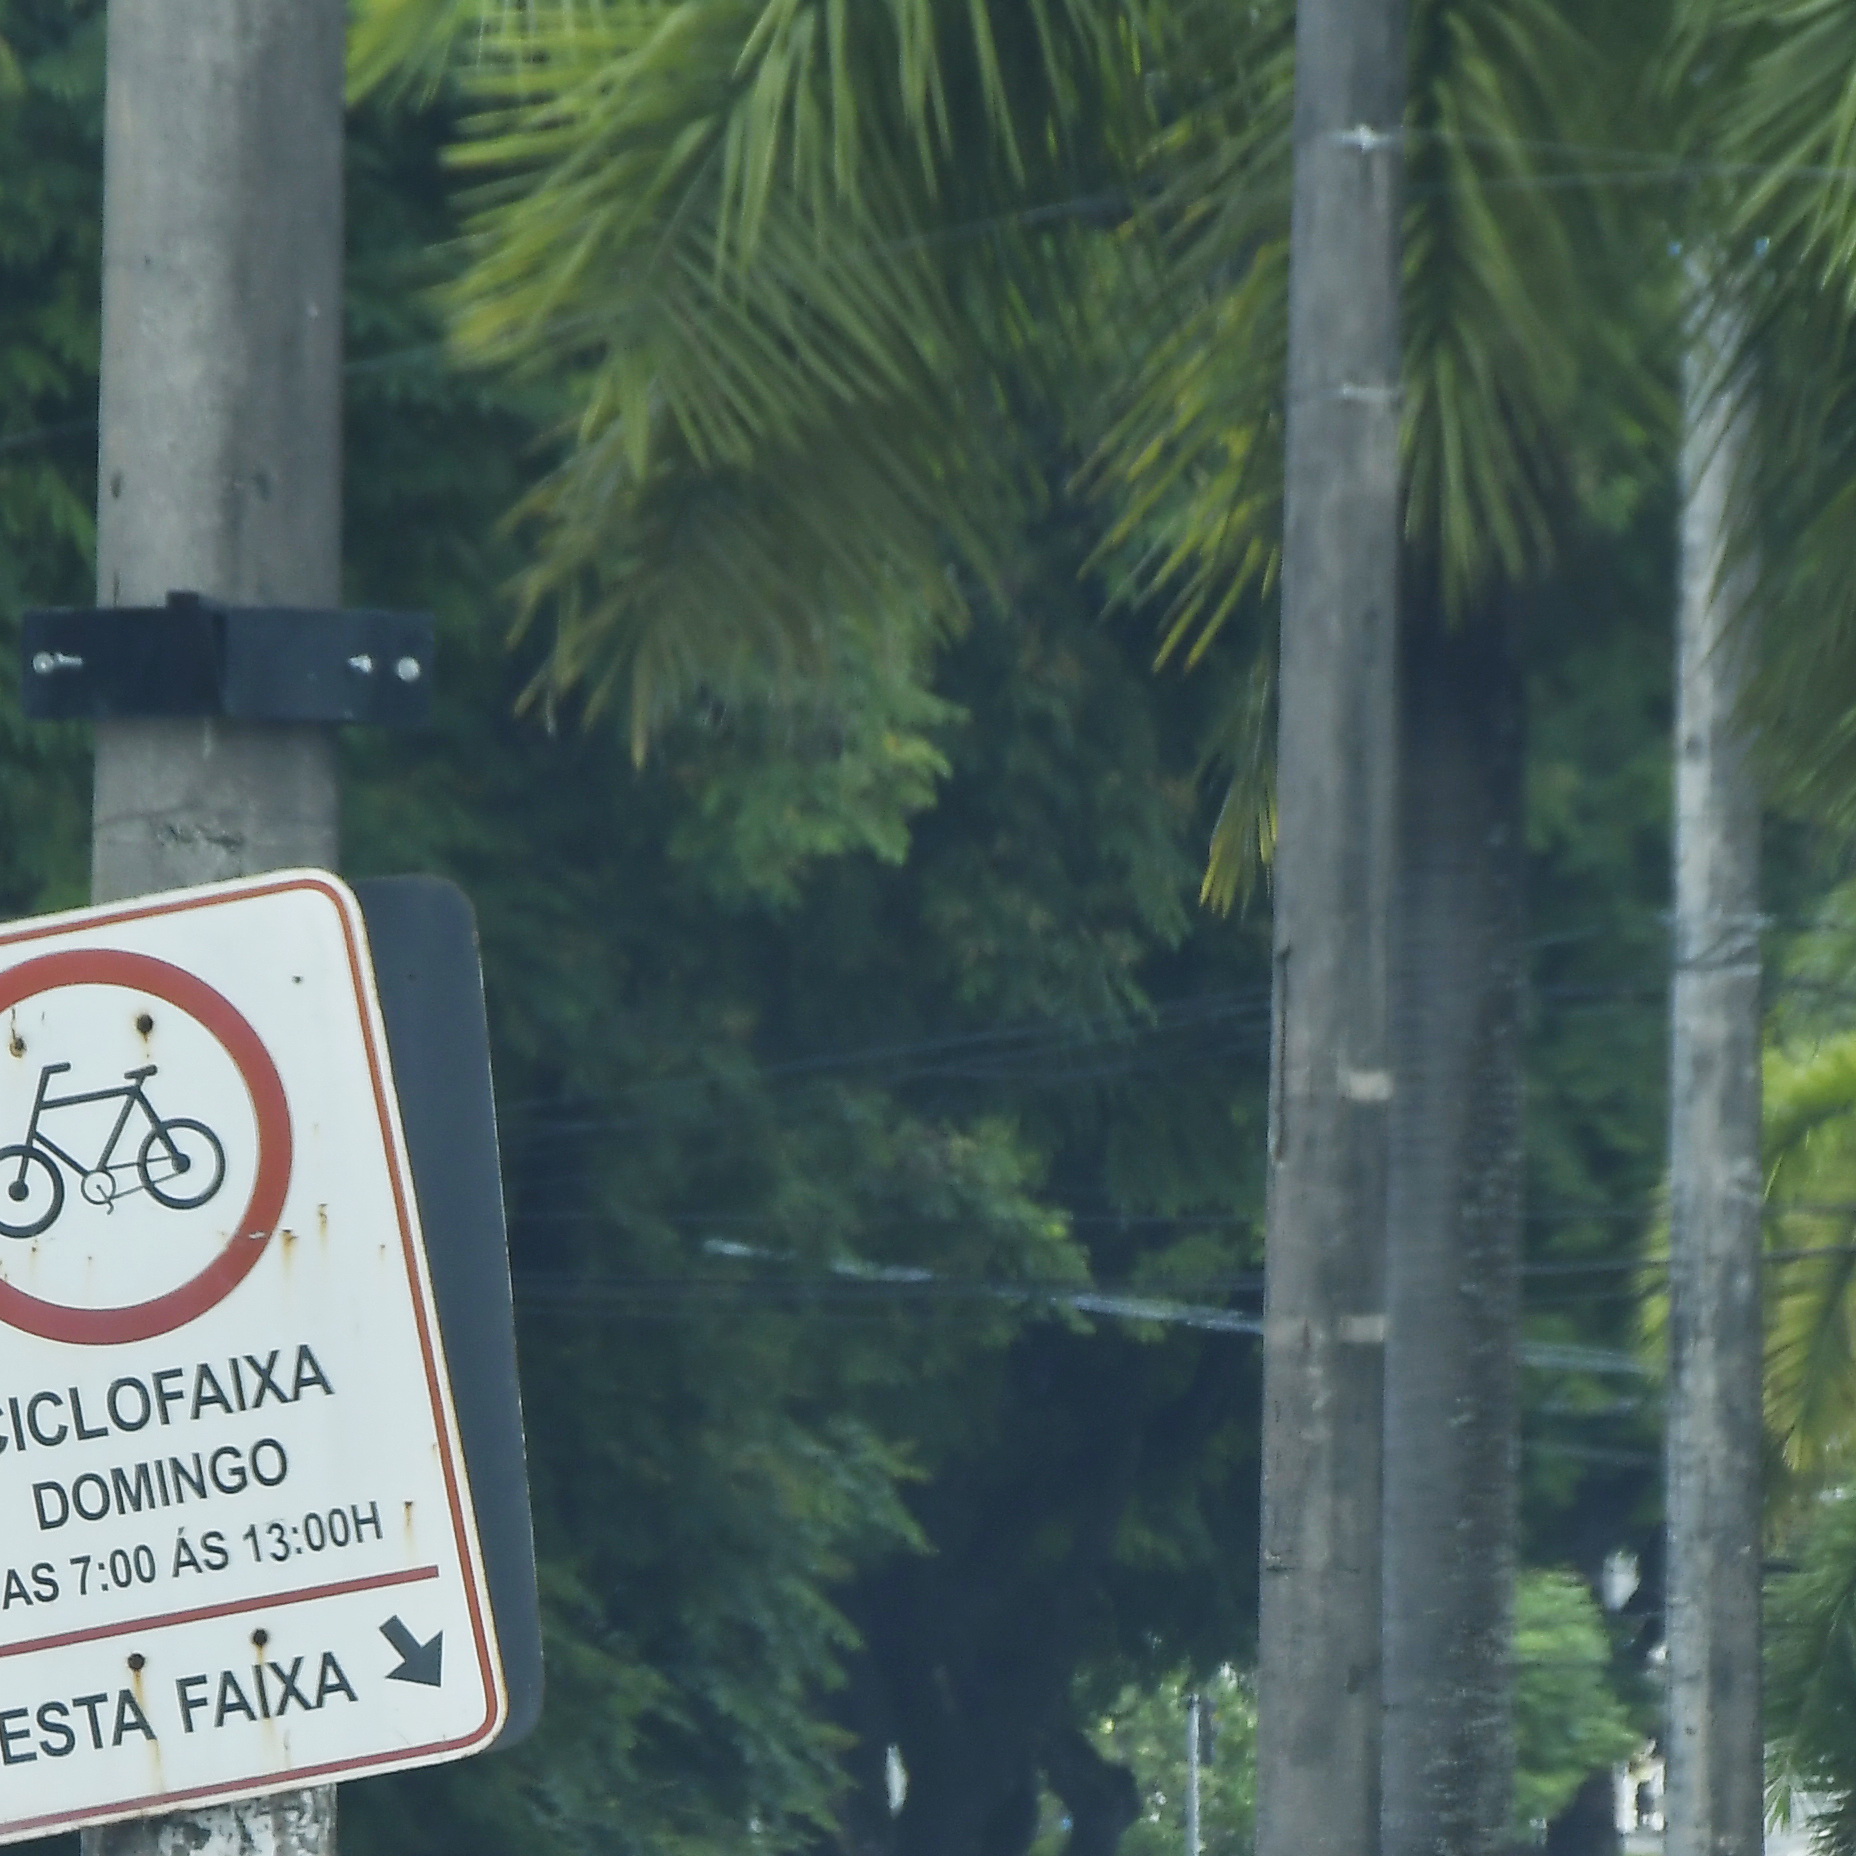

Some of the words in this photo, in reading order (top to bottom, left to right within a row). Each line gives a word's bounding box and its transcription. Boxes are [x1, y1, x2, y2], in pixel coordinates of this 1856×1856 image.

[31, 1437, 290, 1531] DOMINGO
[70, 1543, 157, 1597] 7:00
[243, 1501, 383, 1564] 13:00H
[177, 1649, 358, 1734] FAIXA
